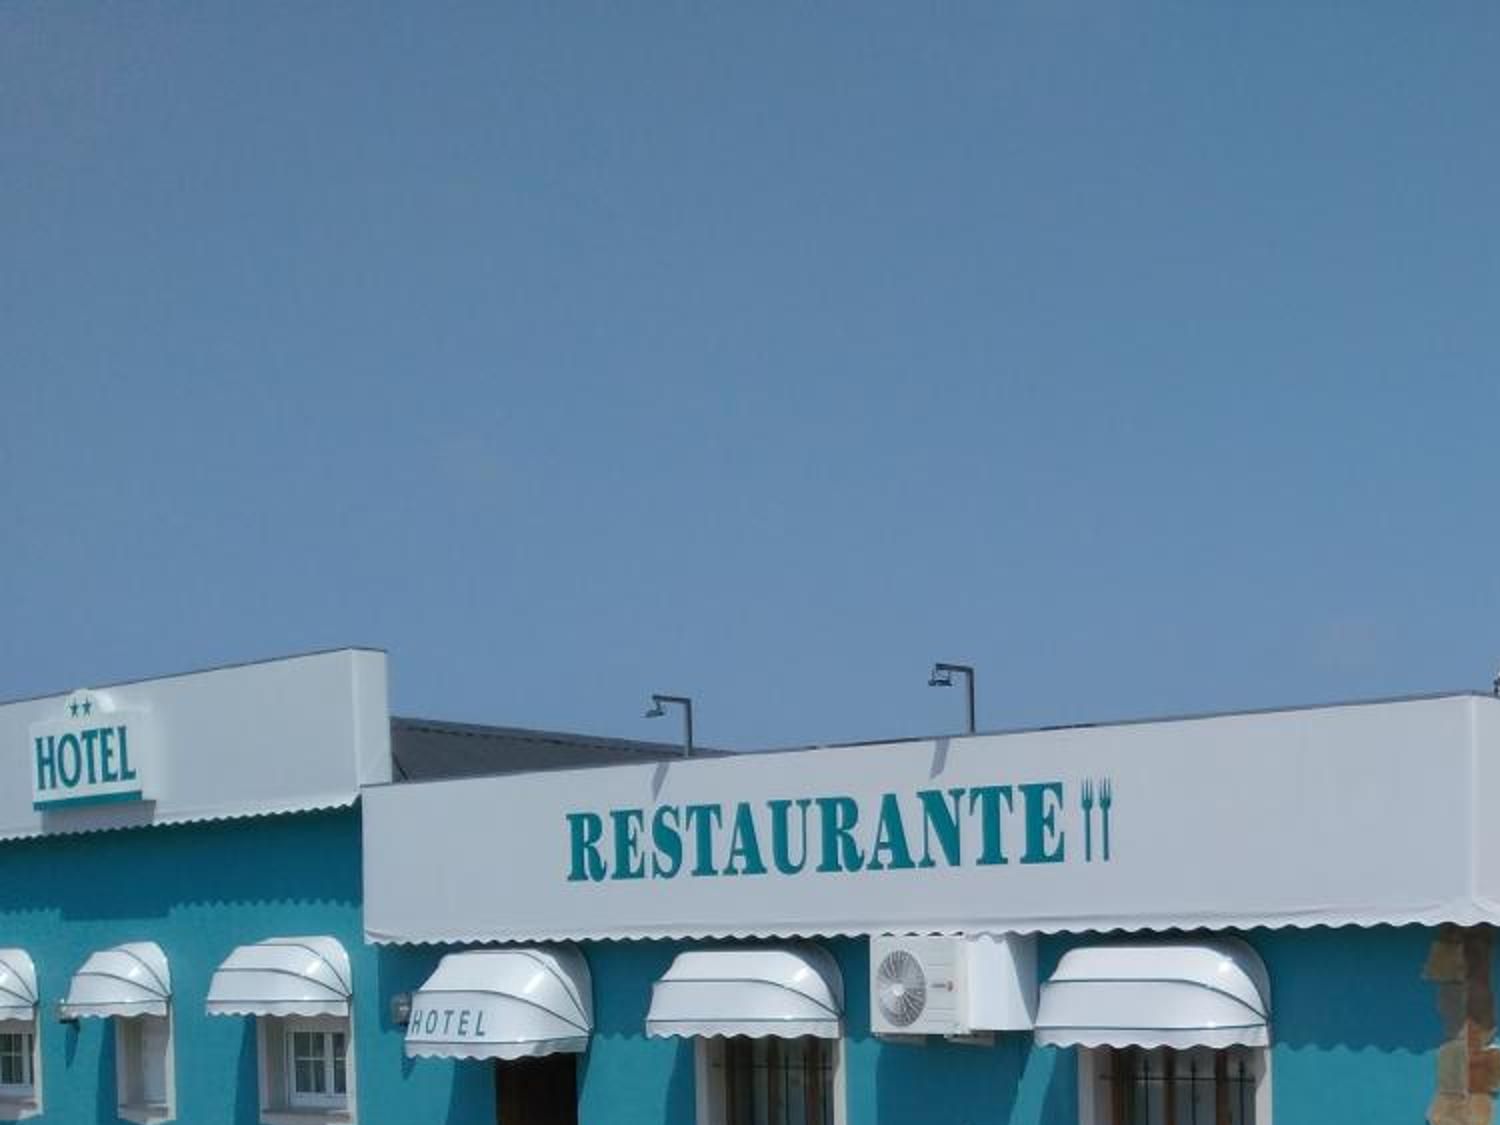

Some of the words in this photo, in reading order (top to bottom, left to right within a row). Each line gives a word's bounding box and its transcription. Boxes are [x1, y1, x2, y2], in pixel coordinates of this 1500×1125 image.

[34, 726, 136, 789] HOTEL
[566, 782, 1066, 882] RESTAURANTE
[411, 1009, 485, 1037] HOTEL
